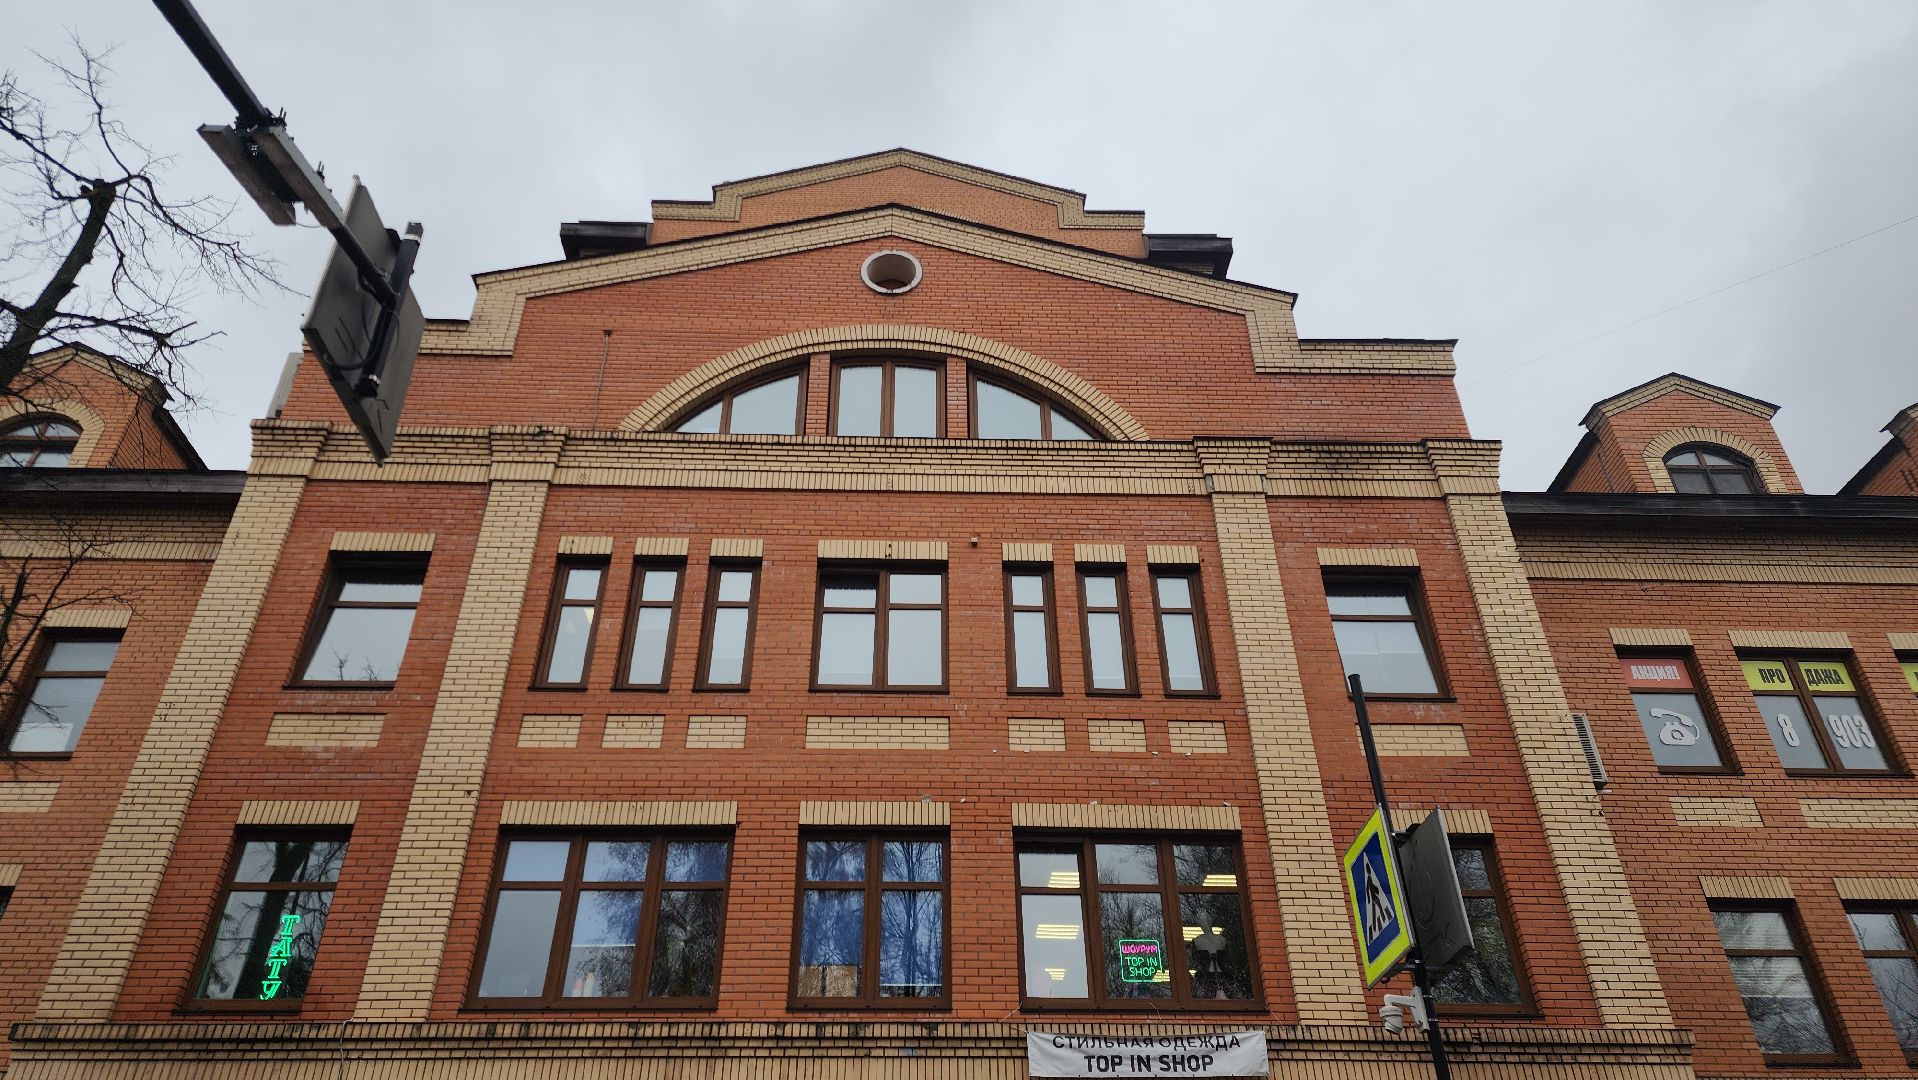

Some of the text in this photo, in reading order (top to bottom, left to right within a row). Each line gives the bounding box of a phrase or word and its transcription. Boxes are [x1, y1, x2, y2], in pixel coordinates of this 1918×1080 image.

[1758, 668, 1845, 686] ПРО ДАЖА
[1776, 713, 1876, 748] 8 903
[259, 914, 301, 1000] ТАТУ
[1125, 956, 1158, 967] TOP IN
[1129, 966, 1156, 977] SHOP
[1052, 1034, 1241, 1051] СТИЛЬНАЯ ОДЕЖДА
[1084, 1054, 1214, 1072] TOP IN SHOP
